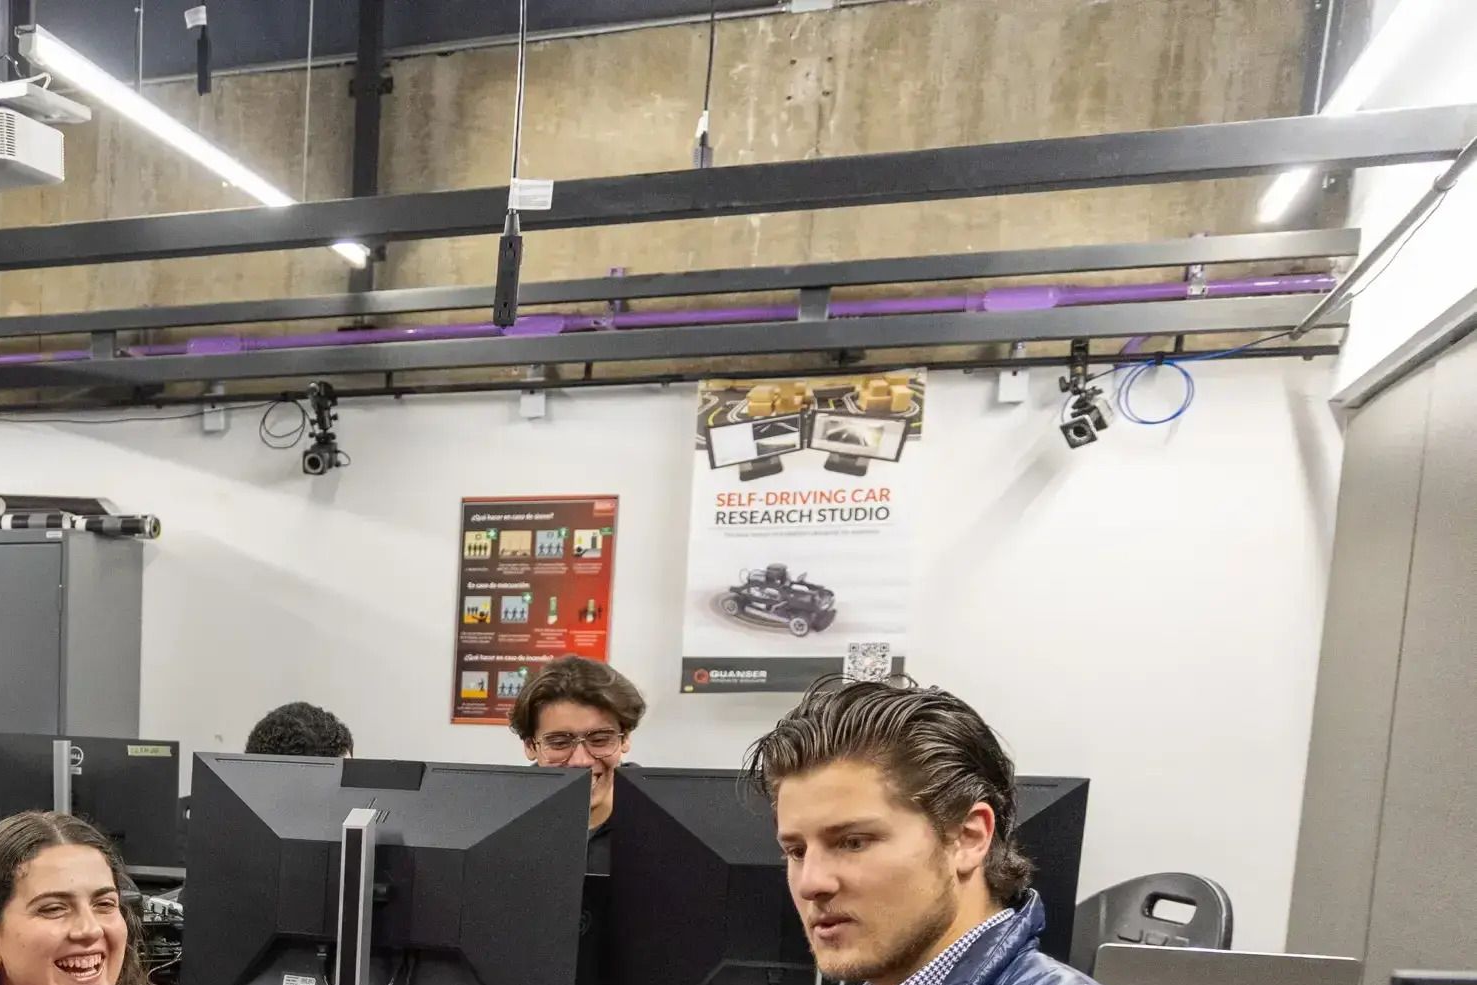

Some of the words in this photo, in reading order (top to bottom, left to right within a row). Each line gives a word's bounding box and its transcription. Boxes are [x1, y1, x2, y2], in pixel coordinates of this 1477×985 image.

[715, 489, 847, 507] SELF-DRIVING
[851, 488, 891, 503] CAR
[714, 509, 812, 525] RESEARCH
[816, 506, 890, 522] STUDIO
